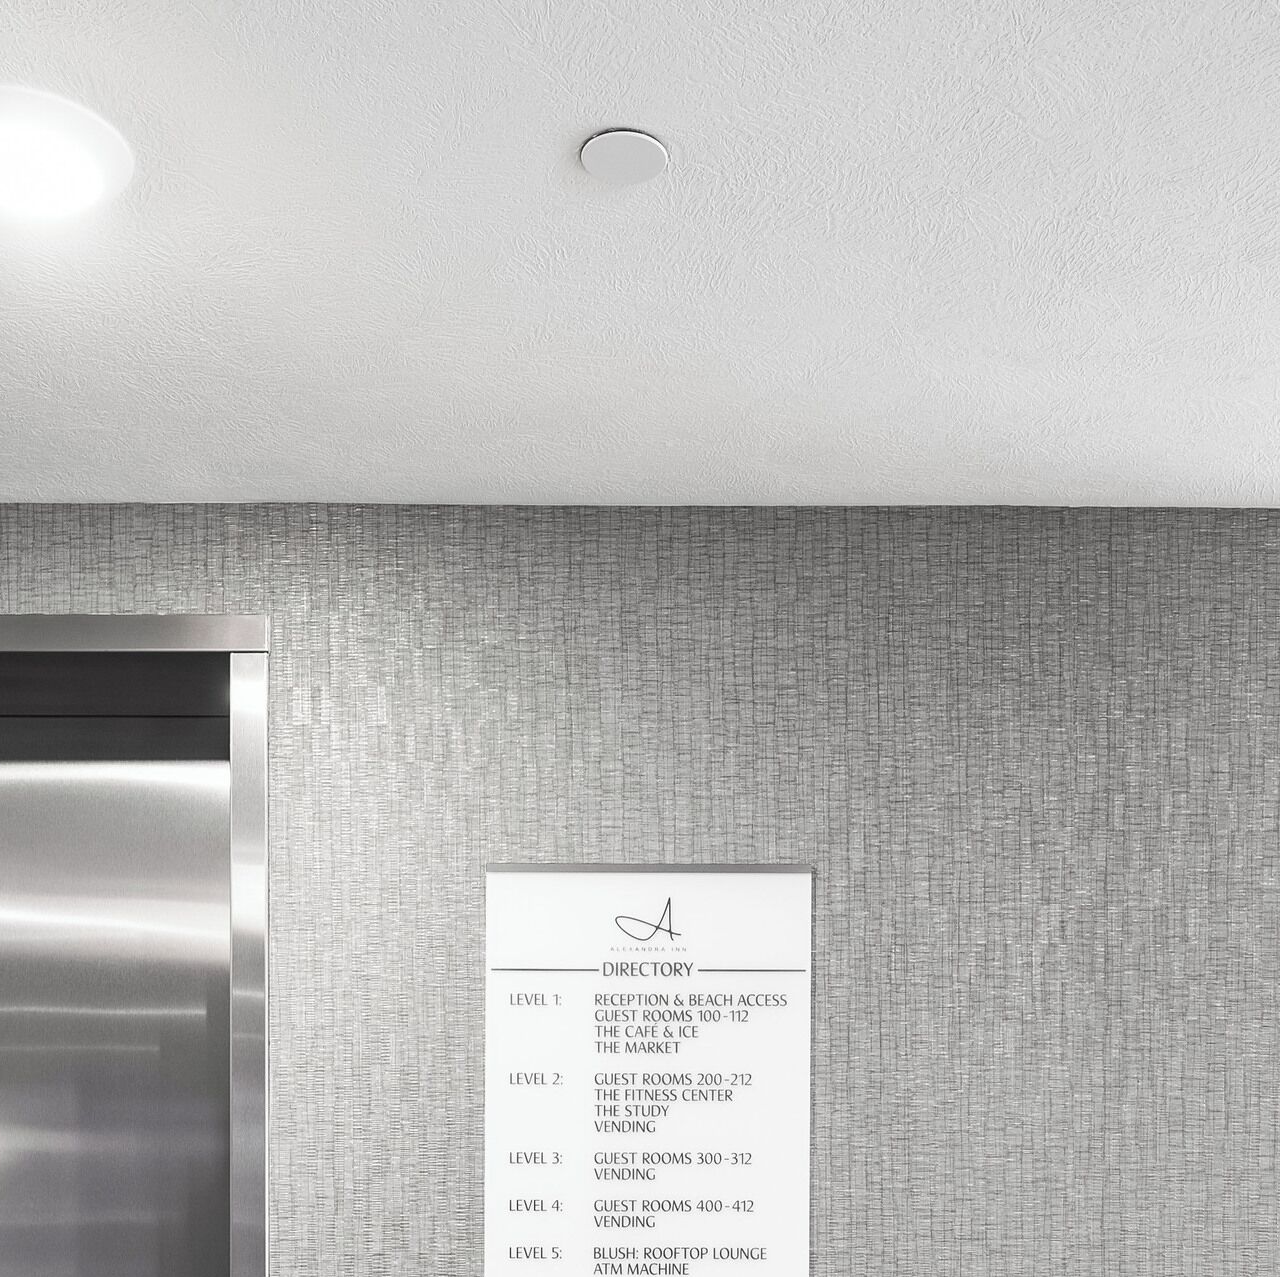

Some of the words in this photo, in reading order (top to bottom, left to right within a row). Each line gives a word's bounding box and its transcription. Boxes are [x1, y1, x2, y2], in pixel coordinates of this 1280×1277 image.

[603, 962, 694, 977] DIRECTORY
[510, 994, 548, 1006] LEVEL
[553, 994, 562, 1006] 1:
[595, 994, 669, 1006] RECEPTION
[674, 994, 685, 1006] &
[689, 994, 733, 1006] BEACH
[737, 994, 788, 1006] ACCESS
[595, 1010, 639, 1022] GUEST
[643, 1010, 693, 1022] ROOMS
[595, 1025, 621, 1038] THE
[625, 1023, 659, 1038] CAFÉ
[663, 1026, 674, 1038] &
[679, 1026, 699, 1038] ICE
[595, 1042, 621, 1053] THE
[625, 1042, 681, 1054] MARKET
[510, 1073, 547, 1085] LEVEL
[552, 1073, 563, 1085] 2:
[595, 1073, 638, 1086] GUEST
[643, 1073, 693, 1086] ROOMS
[595, 1089, 620, 1101] THE
[625, 1089, 678, 1101] FITNESS
[682, 1089, 733, 1102] CENTER
[595, 1105, 621, 1117] THE
[625, 1105, 670, 1117] STUDY
[594, 1121, 656, 1133] VENDING
[509, 1152, 547, 1164] LEVEL
[552, 1152, 563, 1164] 3:
[594, 1152, 638, 1165] GUEST
[642, 1152, 693, 1165] ROOMS
[594, 1168, 656, 1180] VENDING
[509, 1200, 547, 1212] LEVEL
[551, 1200, 563, 1212] 4:
[594, 1200, 638, 1212] GUEST
[642, 1200, 693, 1212] ROOMS
[594, 1216, 656, 1228] VENDING
[509, 1247, 547, 1259] LEVEL
[551, 1247, 563, 1259] 5:
[593, 1247, 639, 1260] BLUSH:
[643, 1247, 709, 1260] ROOFTOP
[713, 1247, 768, 1260] LOUNGE
[593, 1263, 623, 1275] ATM
[627, 1263, 689, 1275] MACHINE
